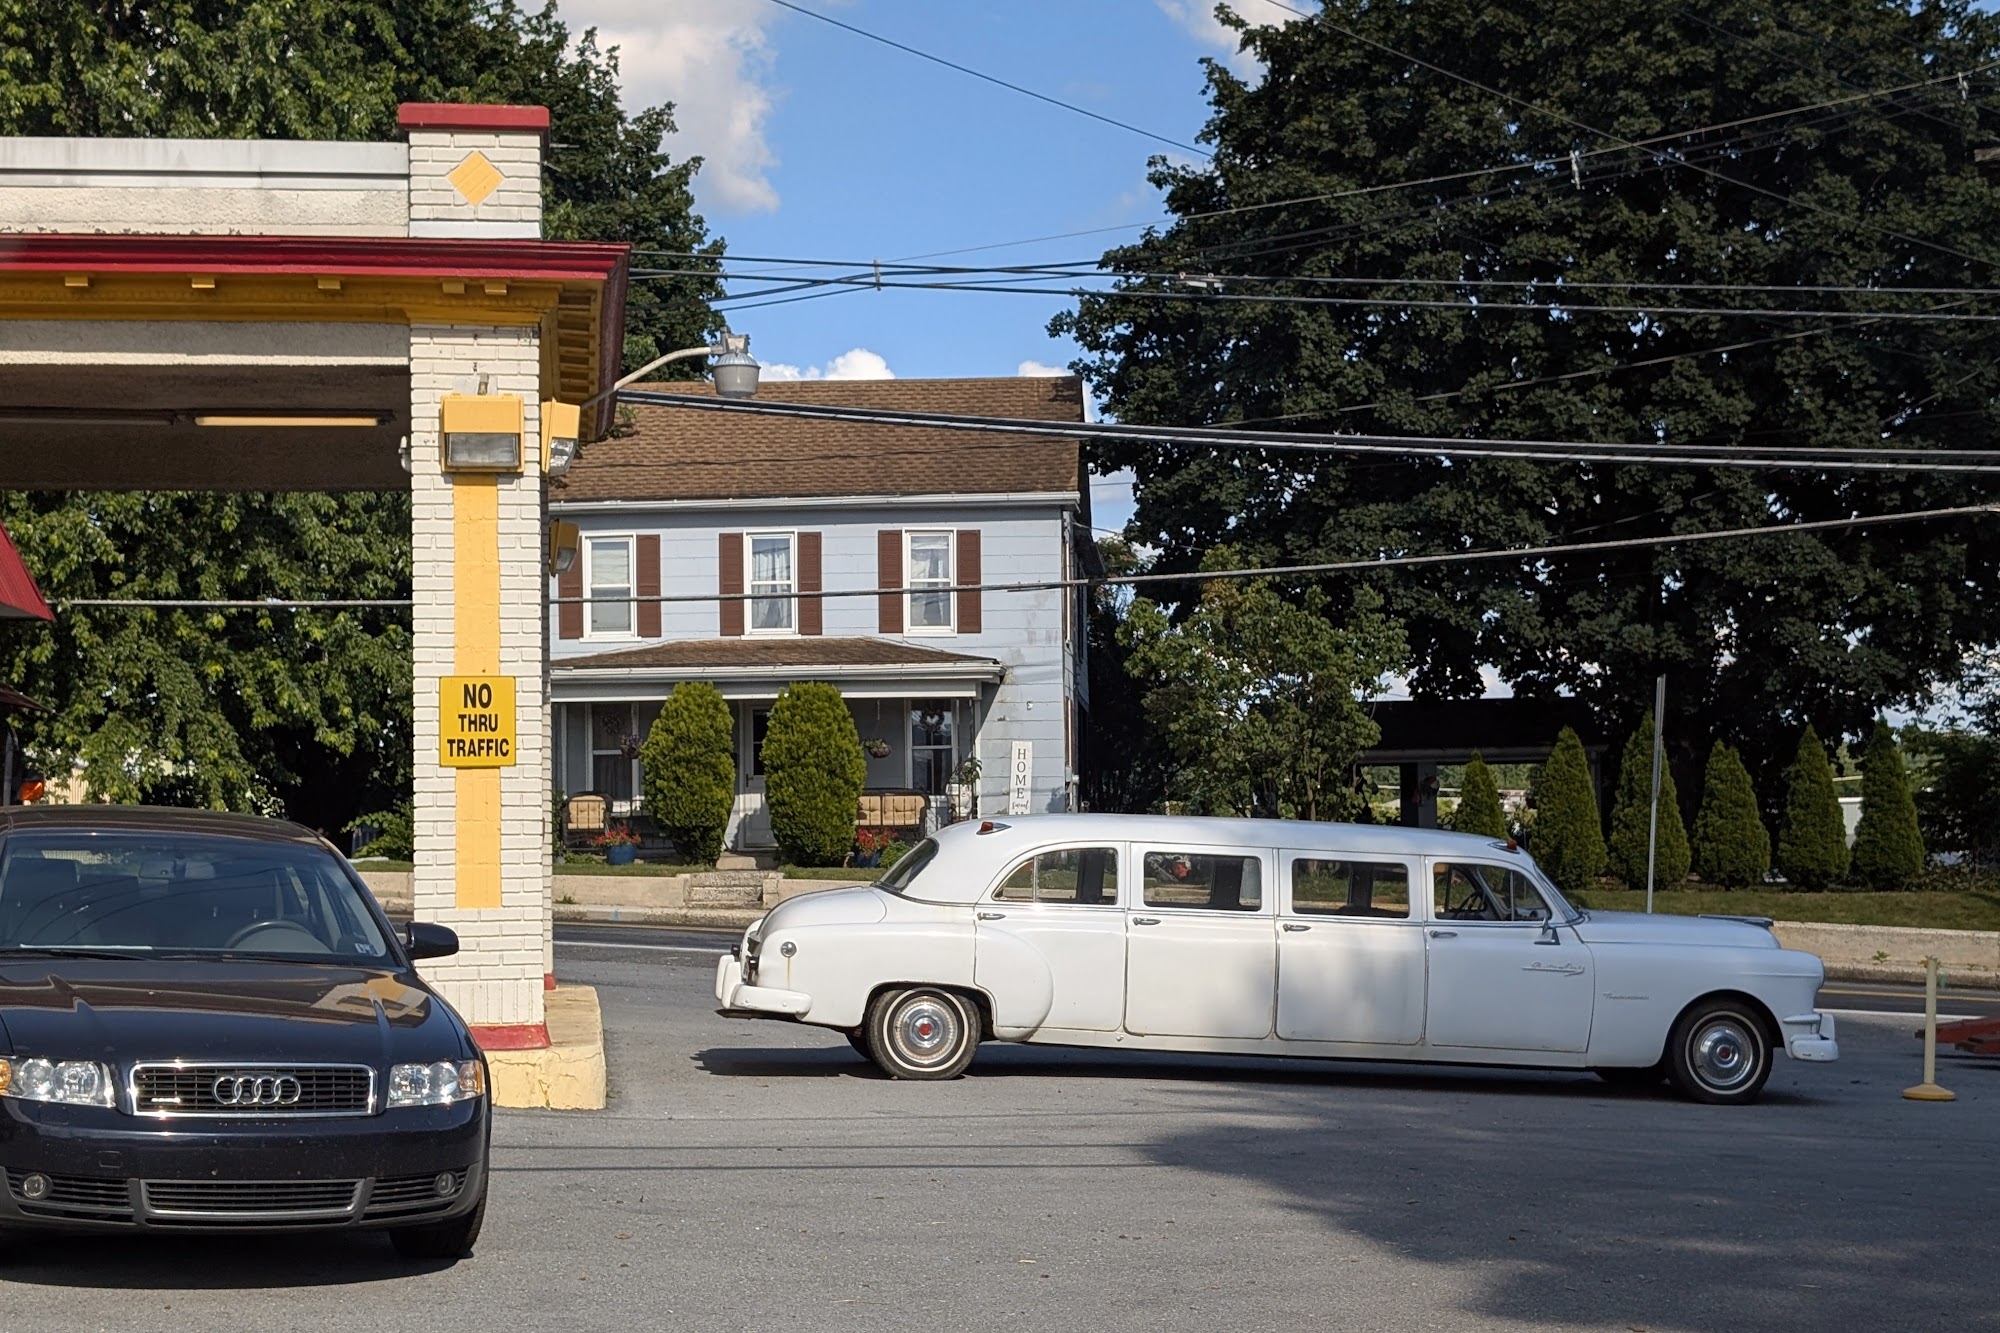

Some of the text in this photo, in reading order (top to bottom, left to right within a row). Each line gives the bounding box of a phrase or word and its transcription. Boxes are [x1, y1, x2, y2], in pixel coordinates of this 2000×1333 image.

[463, 683, 492, 708] NO
[458, 714, 498, 732] THRU
[447, 738, 510, 757] TRAFFIC
[1015, 748, 1027, 799] HOME
